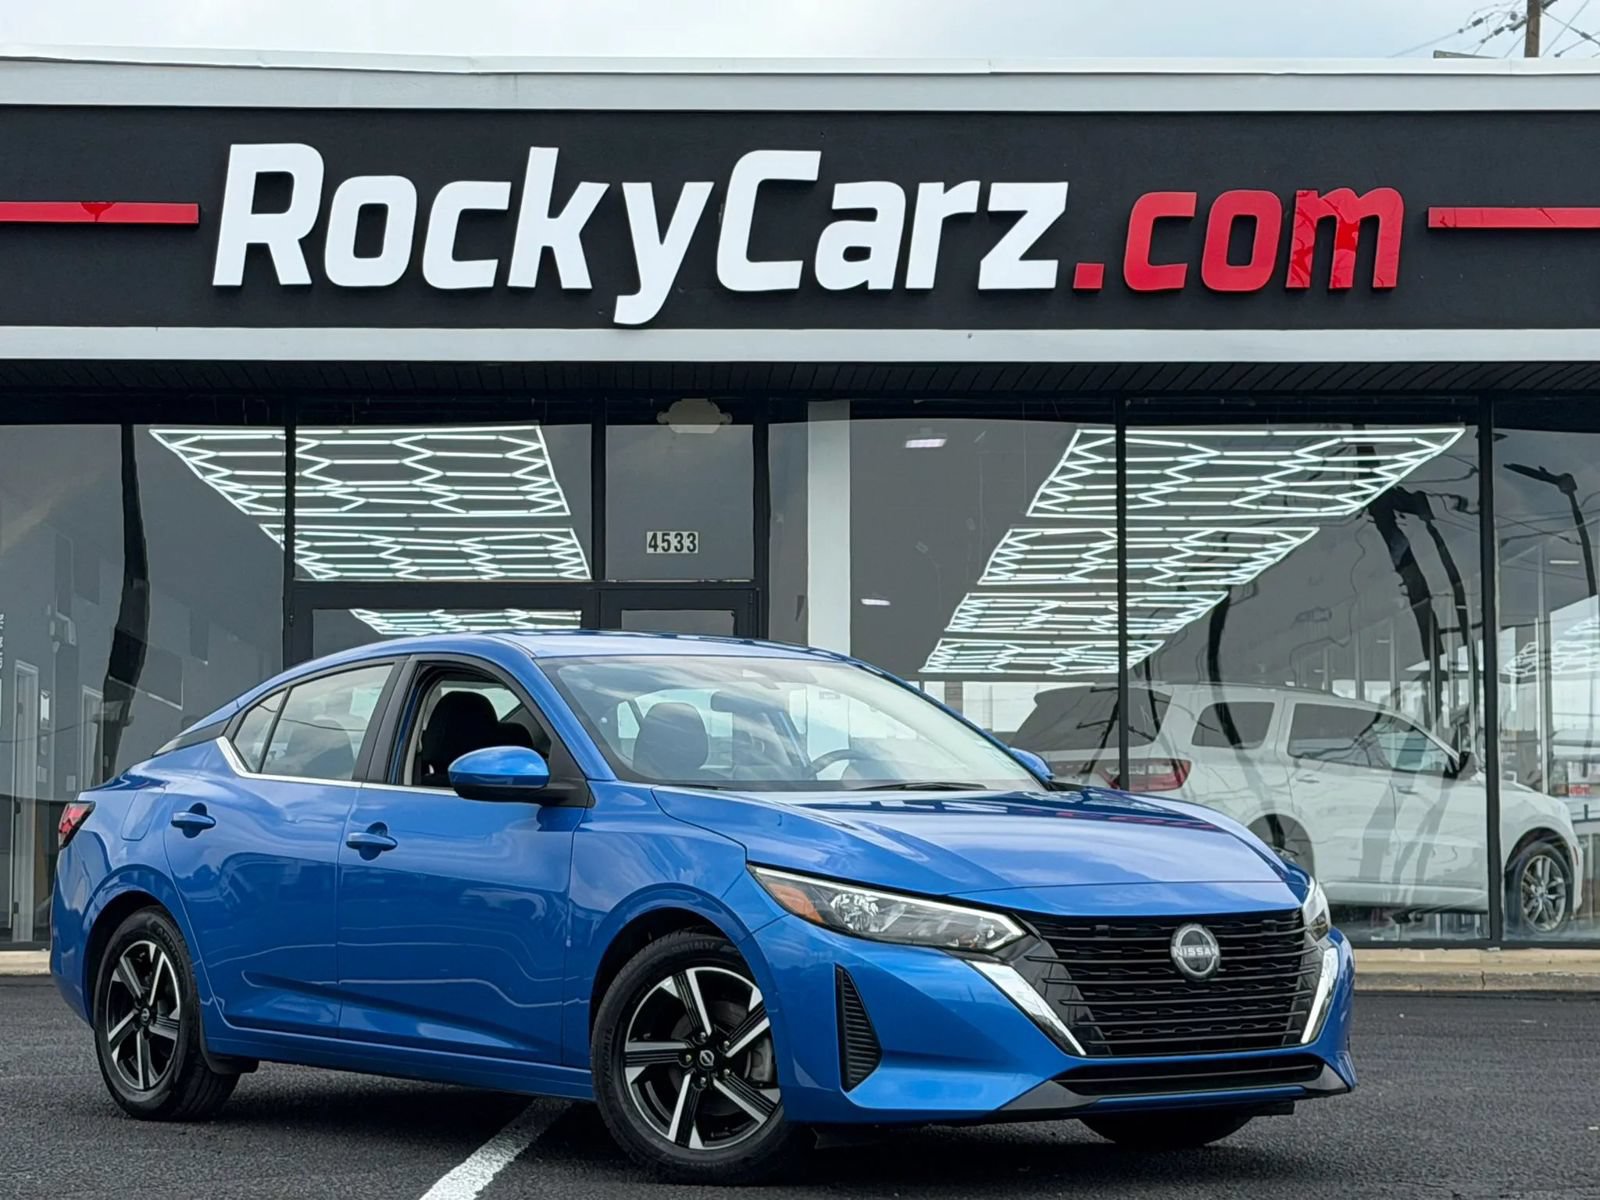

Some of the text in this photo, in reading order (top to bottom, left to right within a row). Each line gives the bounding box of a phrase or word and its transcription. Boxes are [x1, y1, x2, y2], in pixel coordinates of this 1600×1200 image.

[212, 143, 1404, 325] RockyCarz.com
[648, 532, 697, 552] 4533
[1175, 946, 1218, 958] NISSAN
